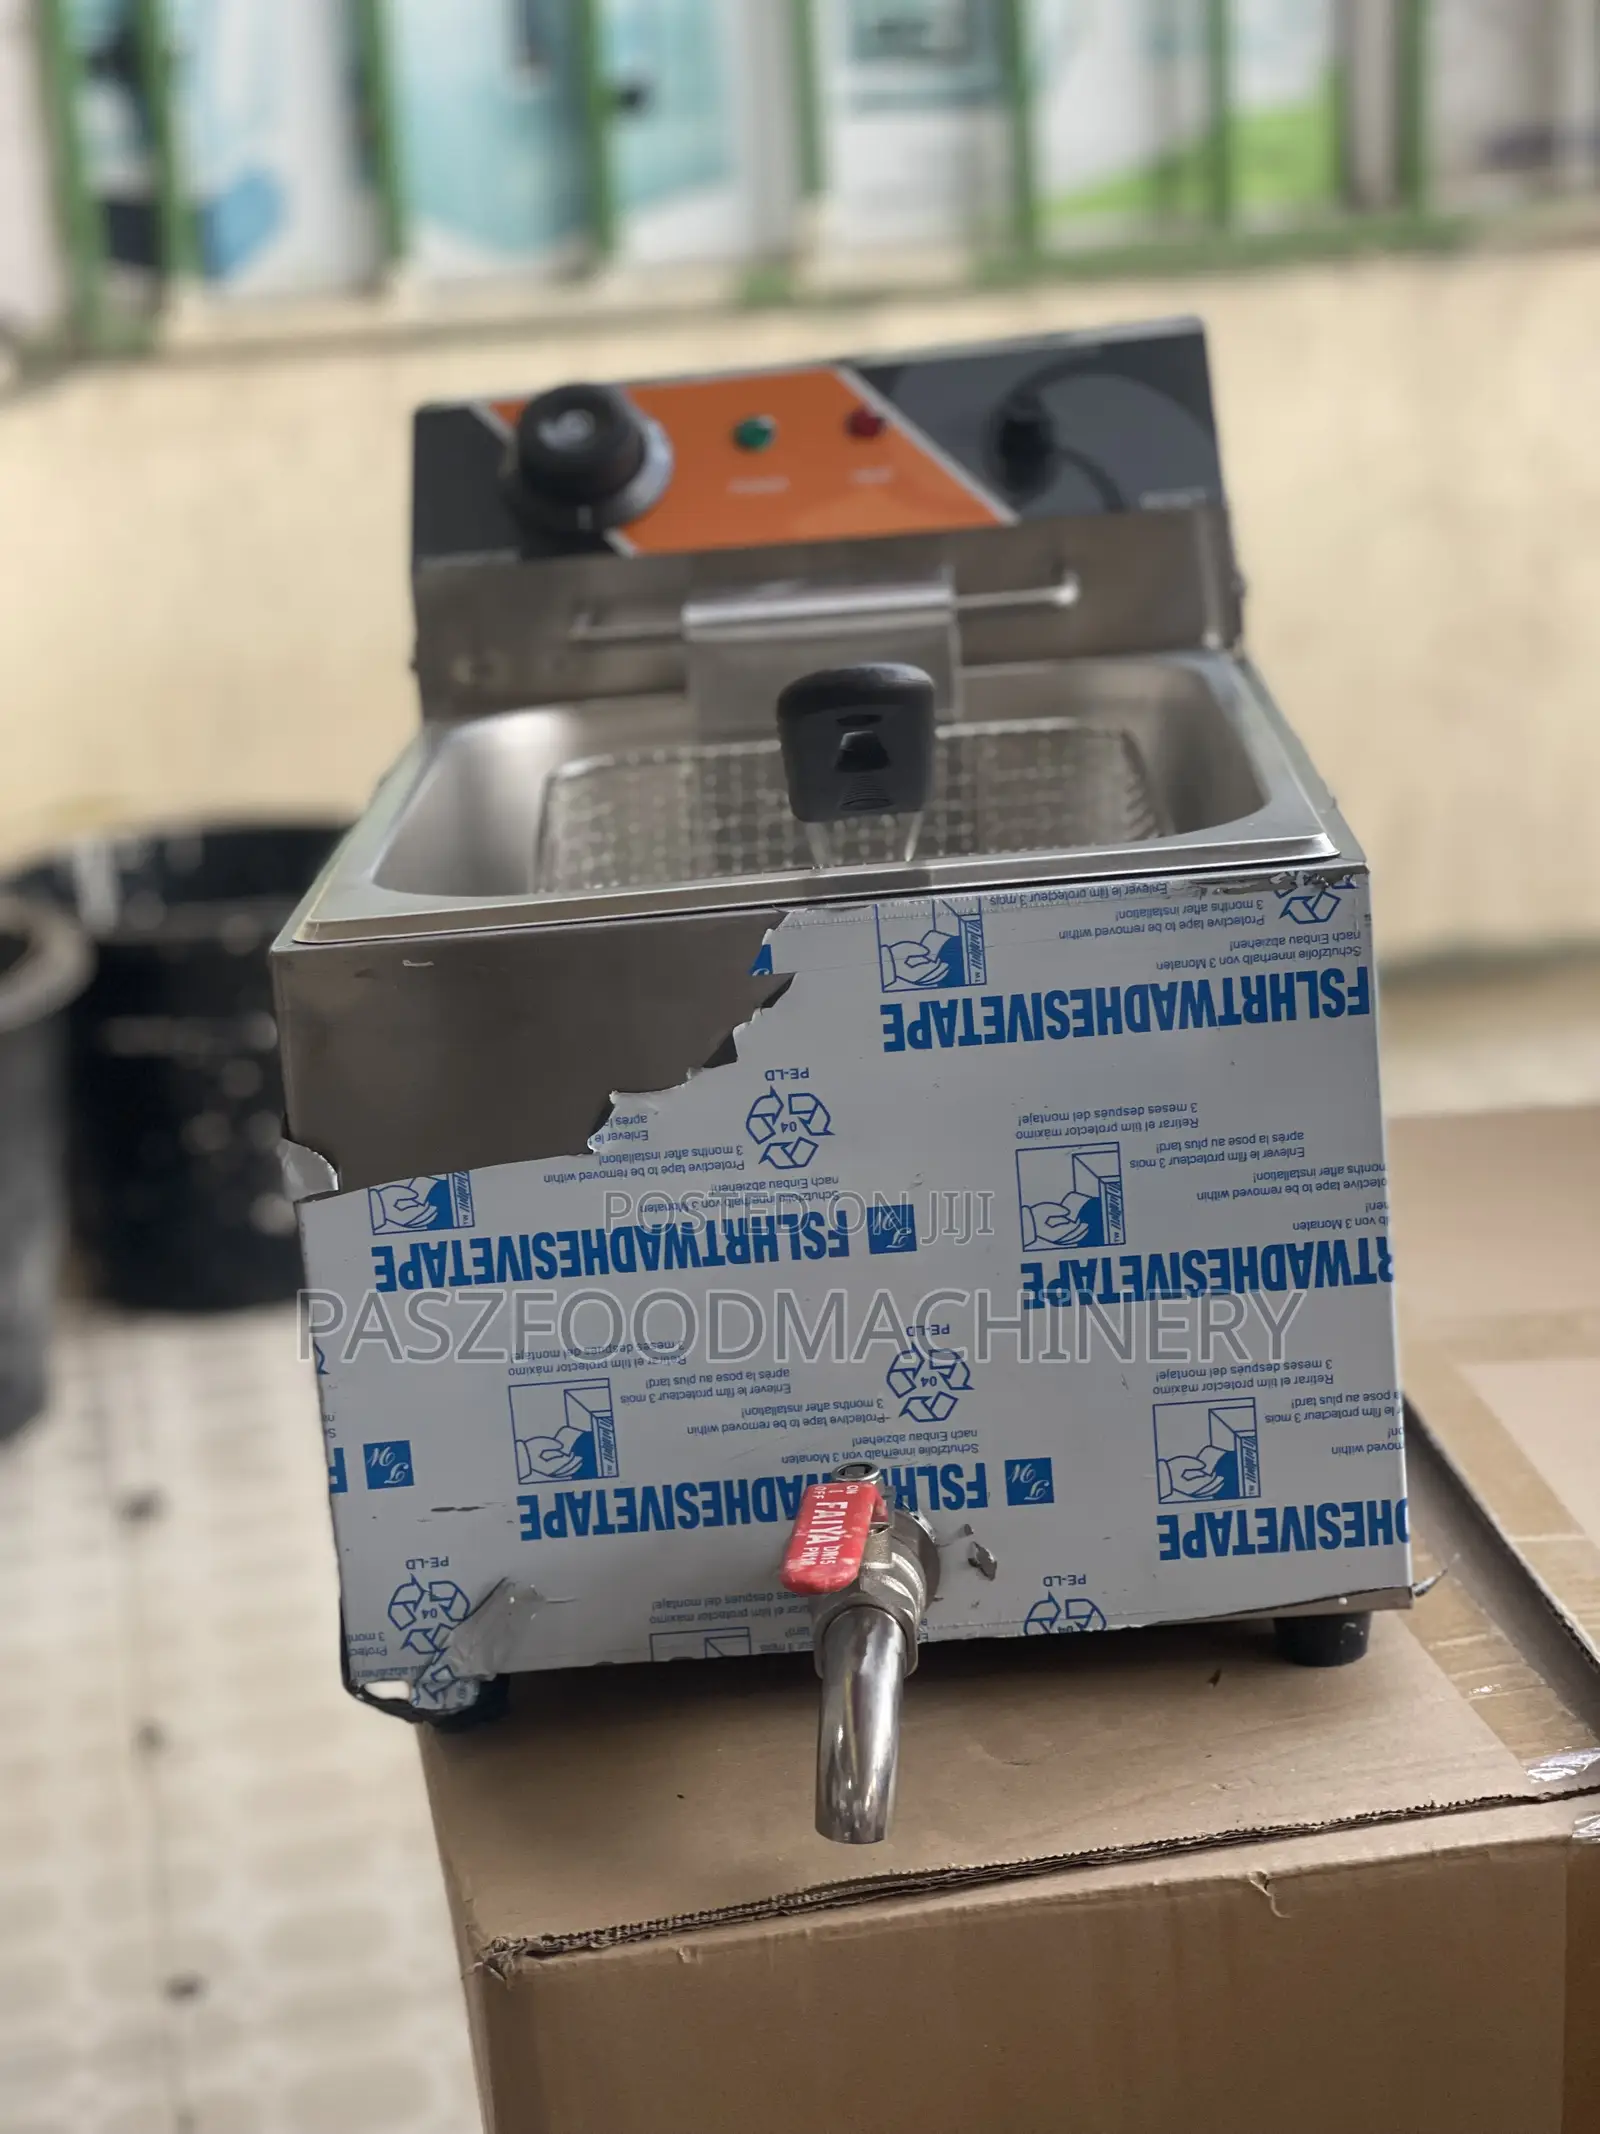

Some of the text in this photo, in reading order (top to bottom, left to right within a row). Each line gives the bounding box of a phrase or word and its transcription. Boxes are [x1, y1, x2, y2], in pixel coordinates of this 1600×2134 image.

[1114, 899, 1263, 920] 3 months after installation!
[1058, 914, 1264, 940] Protective tape to be removed within
[1228, 930, 1361, 950] nach Einbau abziehen!
[1155, 945, 1362, 972] Schutzfolie innerhalb von 3 Monaten
[879, 965, 1370, 1052] FSLHRTWADHESIVETAPE
[763, 1066, 809, 1081] PE-LD
[614, 1112, 647, 1128] après
[1017, 1102, 1197, 1126] 3 meses después del montaje!
[779, 1120, 797, 1133] 04
[1064, 1120, 1117, 1137] protector
[1144, 1120, 1155, 1131] el
[1157, 1117, 1198, 1130] Retirar
[594, 1134, 604, 1145] le
[606, 1129, 648, 1144] Enlever
[1014, 1127, 1062, 1141] máximo
[1155, 1129, 1304, 1154] après la pose au plus tard!
[598, 1144, 743, 1165] 3 months after installation!
[1129, 1146, 1305, 1170] Enlever le film protecteur 3 mois
[542, 1159, 744, 1185] Protective tape to be removed within
[1252, 1167, 1317, 1183] installation!
[1318, 1165, 1345, 1178] after
[767, 1177, 808, 1190] Einbau
[810, 1175, 839, 1187] nach
[1300, 1183, 1312, 1194] to
[1313, 1178, 1340, 1193] tape
[1196, 1189, 1229, 1202] within
[1231, 1185, 1282, 1199] removed
[1283, 1184, 1299, 1195] be
[1292, 1216, 1376, 1232] von 3 Monaten
[370, 1208, 849, 1293] FSLHRTWADHESIVETAPE
[905, 1322, 950, 1337] PE-LD
[507, 1364, 553, 1378] máximo
[633, 1358, 645, 1369] el
[1154, 1358, 1332, 1381] 3 meses después del montaje!
[644, 1366, 790, 1389] après la pose au plus tard!
[919, 1374, 937, 1387] 04
[1200, 1377, 1253, 1393] protector
[1279, 1376, 1289, 1387] el
[1293, 1373, 1333, 1386] Retirar
[619, 1383, 791, 1405] Enlever le film protecteur 3 mois
[1152, 1383, 1198, 1396] máximo
[740, 1397, 883, 1418] 3 months after installation!
[1290, 1389, 1390, 1410] pose au plus tard!
[1264, 1405, 1395, 1426] le film protecteur 3 mois
[686, 1412, 884, 1436] Protective tape to be removed within
[851, 1427, 977, 1447] nach Einbau abziehen!
[780, 1441, 979, 1465] Schutzfolie innerhalb von 3 Monaten
[805, 1501, 849, 1545] FAIYA
[404, 1555, 449, 1570] PE-LD
[1041, 1573, 1086, 1587] PE-LD
[420, 1607, 438, 1619] 04
